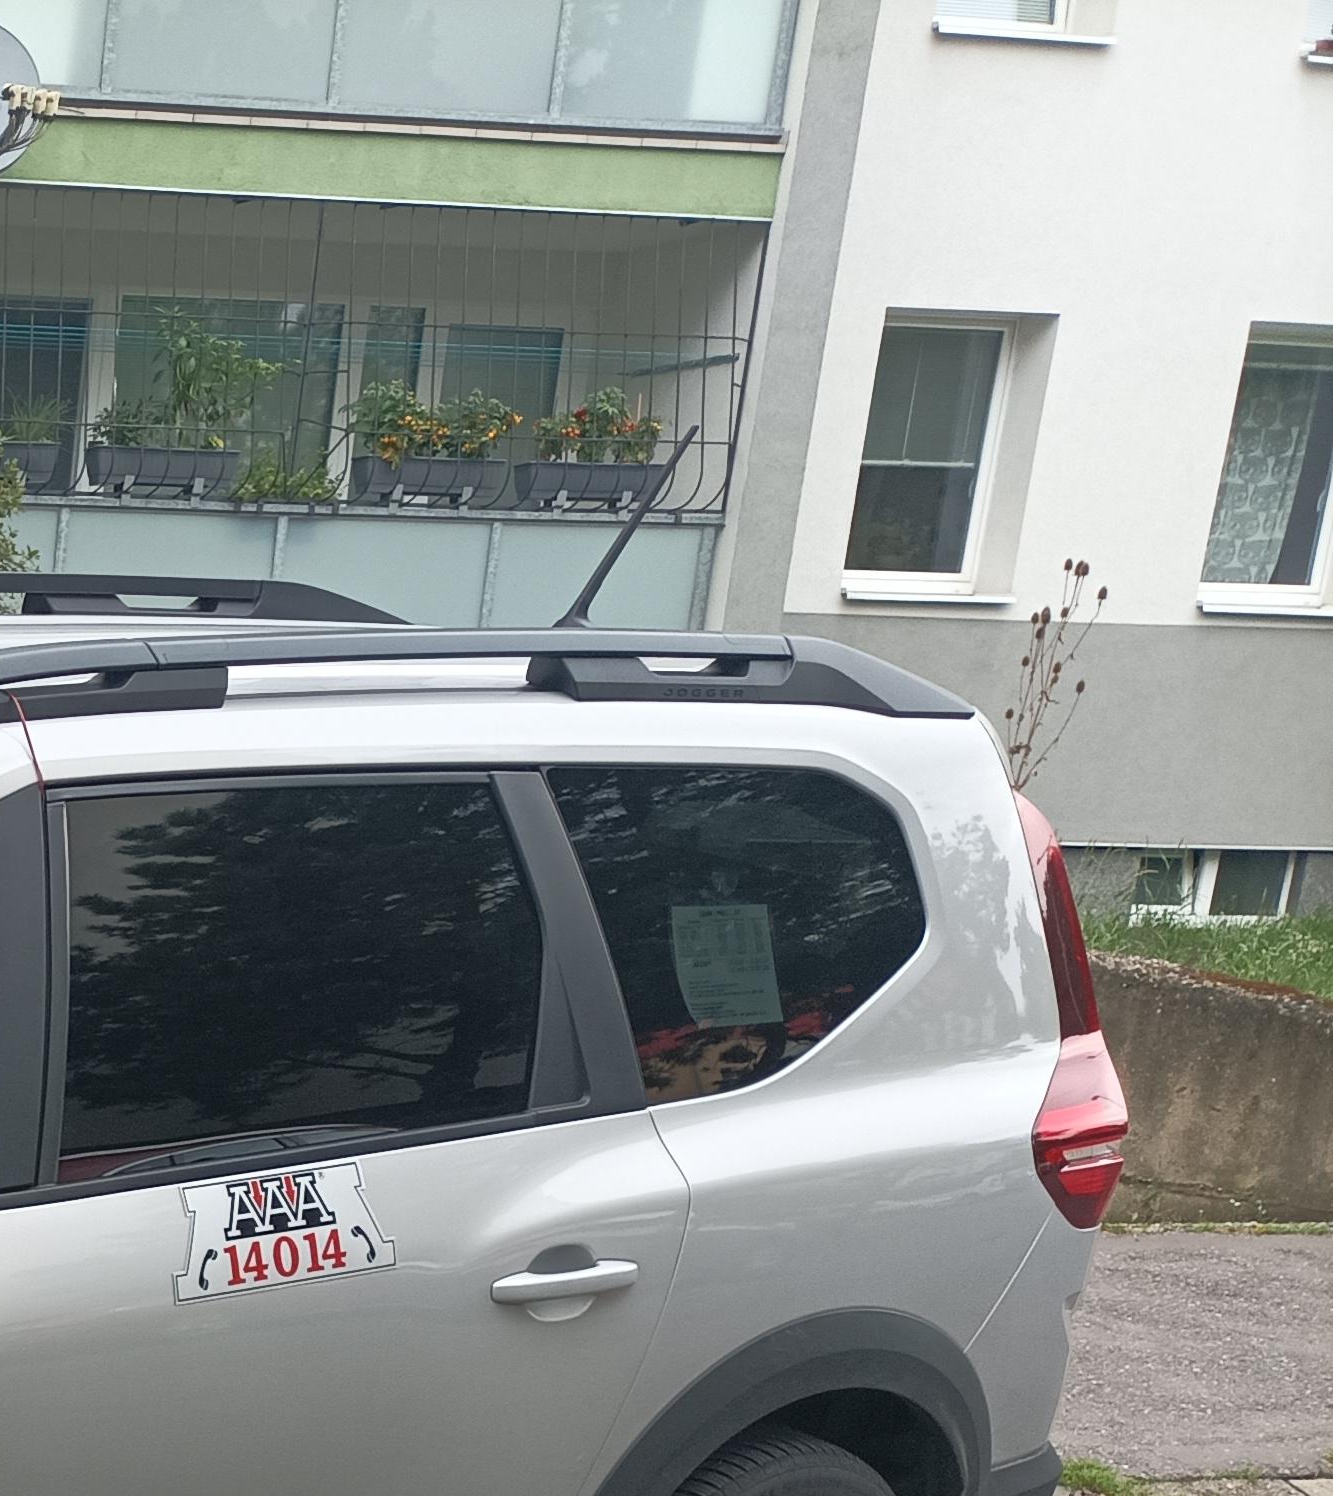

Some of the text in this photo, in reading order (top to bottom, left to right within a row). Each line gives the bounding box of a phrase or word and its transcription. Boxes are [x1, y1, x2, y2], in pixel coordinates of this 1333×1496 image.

[663, 687, 744, 698] JOGGER
[225, 1173, 336, 1240] AAA
[223, 1228, 346, 1286] 14014
